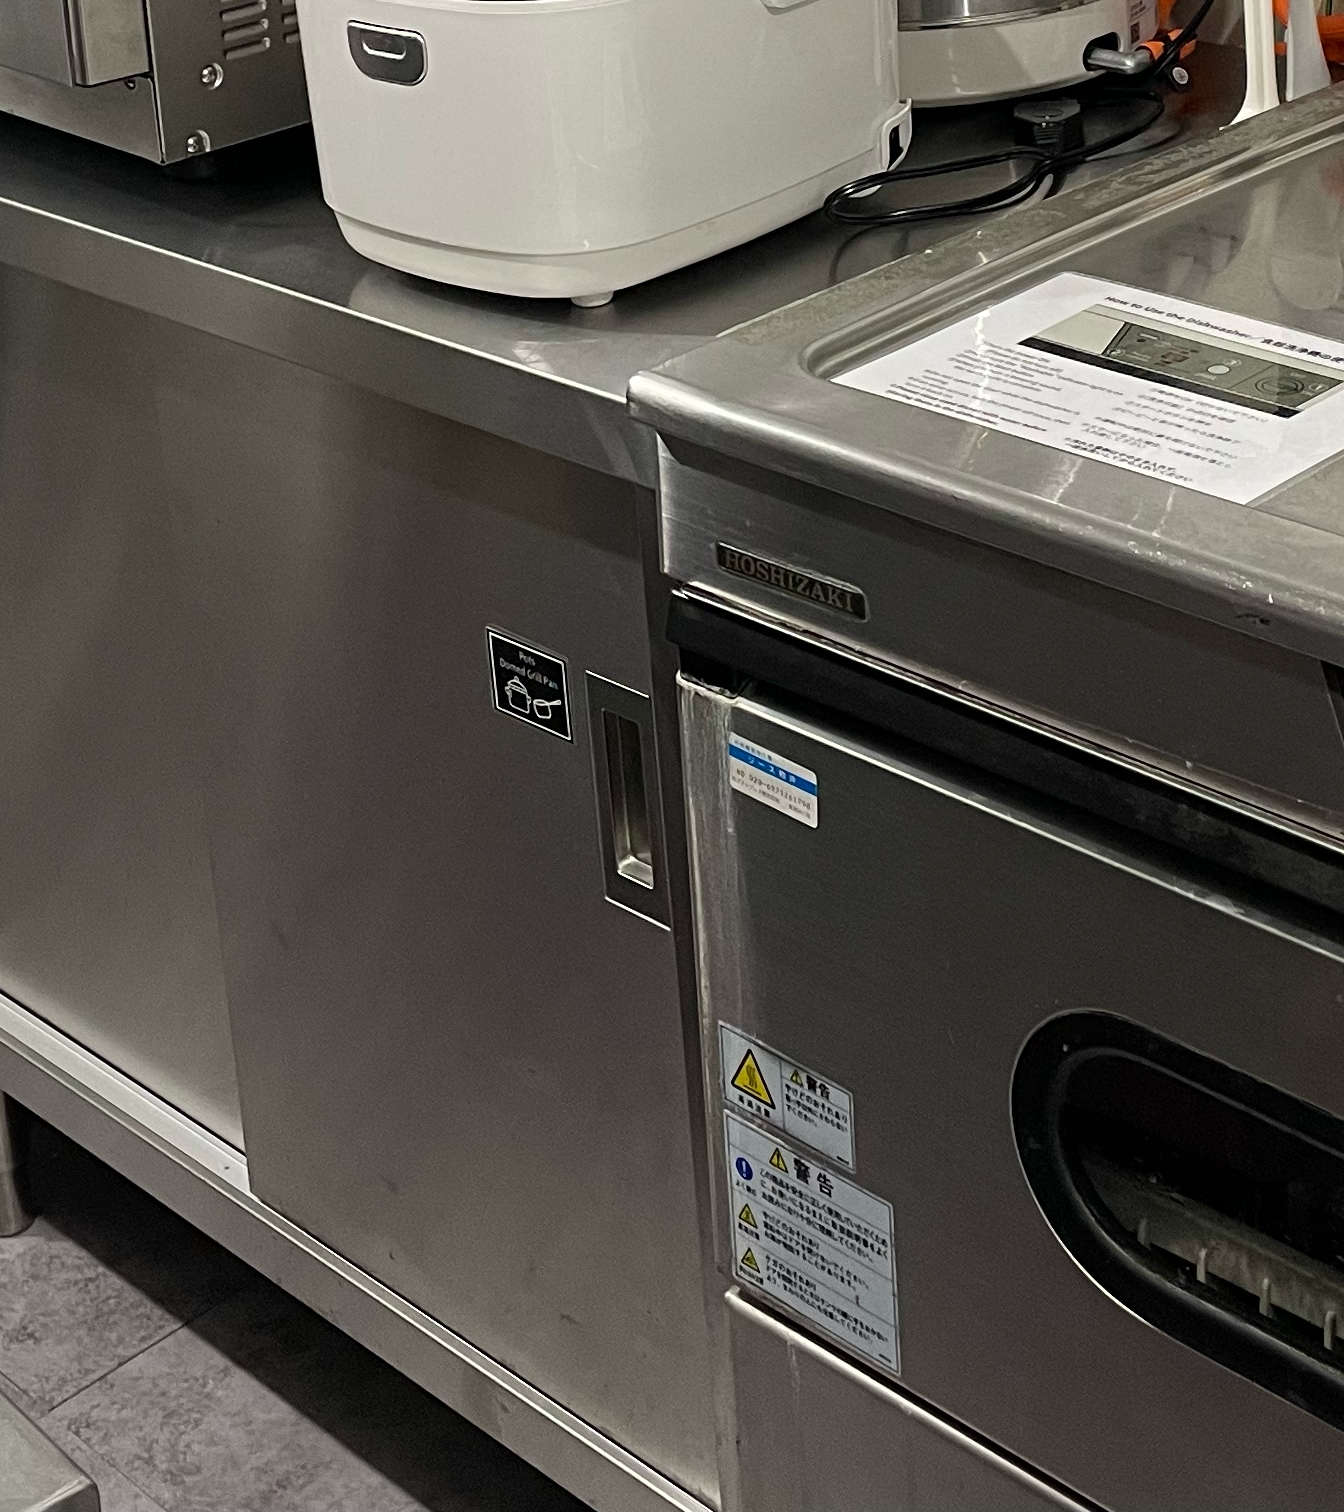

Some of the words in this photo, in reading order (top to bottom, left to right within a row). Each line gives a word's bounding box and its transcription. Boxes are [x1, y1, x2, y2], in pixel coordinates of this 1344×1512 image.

[1104, 296, 1130, 306] How
[1145, 306, 1164, 315] Use
[1166, 312, 1185, 321] the
[725, 549, 856, 612] HOSHIZAKI
[806, 1074, 831, 1100] 警告
[793, 1157, 835, 1198] 警告
